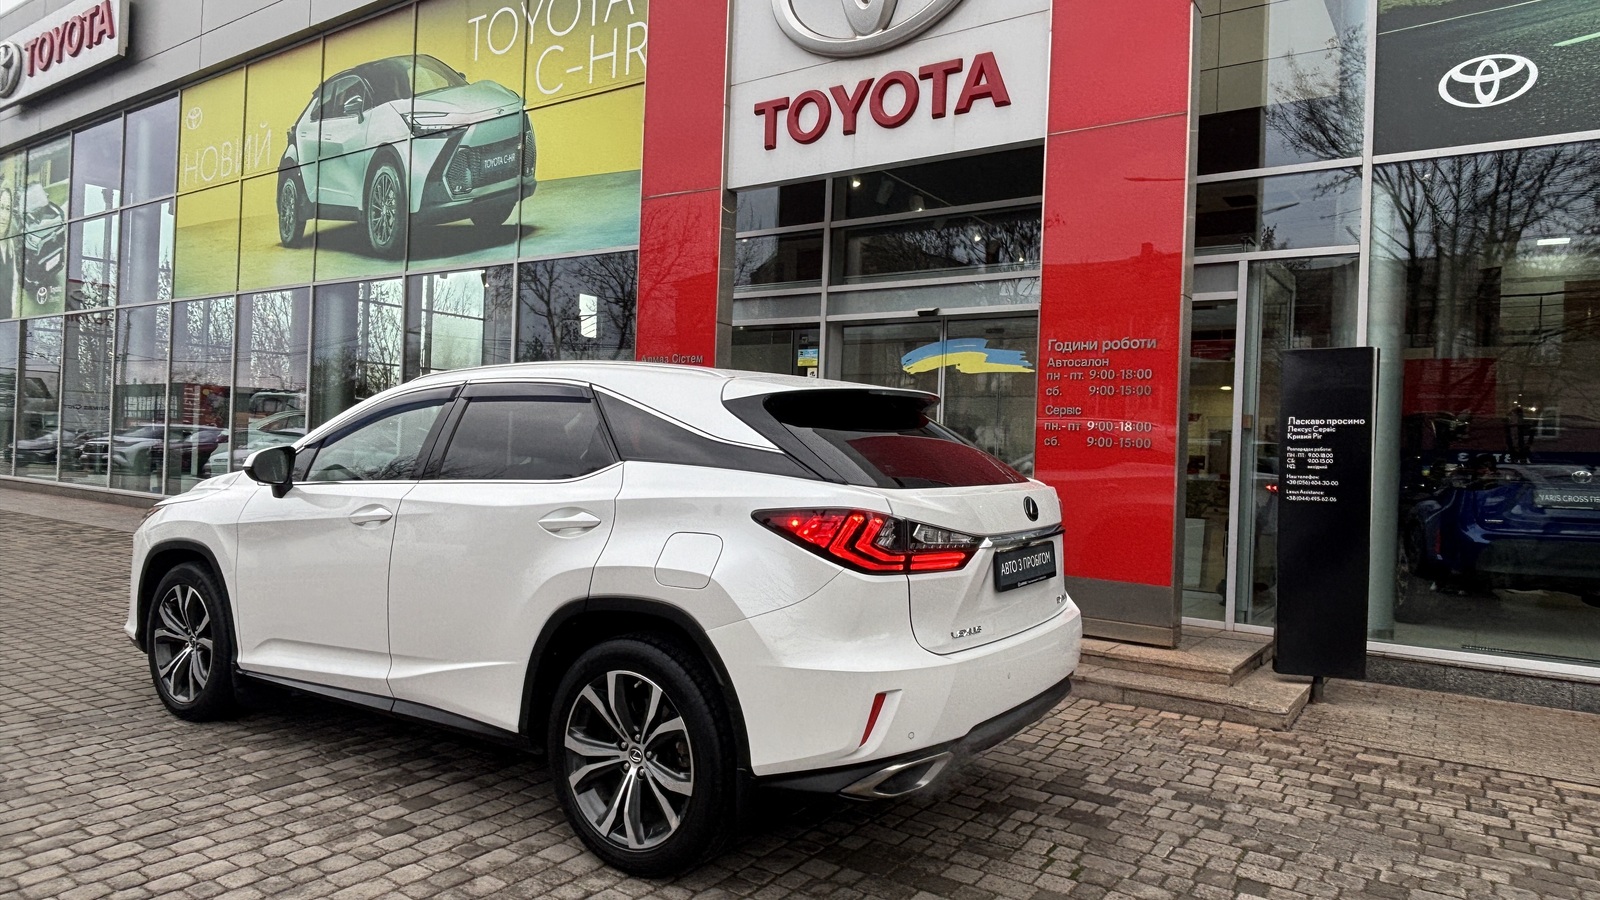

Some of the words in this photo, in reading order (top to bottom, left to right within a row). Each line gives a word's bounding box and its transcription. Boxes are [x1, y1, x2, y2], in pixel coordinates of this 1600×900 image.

[24, 0, 116, 78] TOYOTA
[535, 21, 648, 95] C-HR
[754, 51, 1012, 151] TOYOTA
[184, 122, 272, 186] НОВИЙ
[1047, 339, 1098, 354] Години
[1102, 336, 1157, 354] роботи
[671, 353, 704, 364] Сістем
[1047, 357, 1110, 368] Автосалон
[1045, 386, 1062, 396] сб.
[1045, 405, 1082, 418] Сервіс
[1287, 416, 1325, 425] Ласкаво
[1326, 418, 1366, 427] просимо
[1287, 425, 1312, 433] Лексус
[1312, 425, 1336, 433] Сервіс
[1044, 436, 1060, 446] сб.
[1287, 432, 1312, 440] Кривий
[1312, 432, 1323, 440] Ріг
[1539, 494, 1561, 502] YARIS
[1562, 494, 1588, 503] CROSS
[1001, 560, 1018, 576] АВТО
[1022, 550, 1051, 570] ПРОБІГОМ
